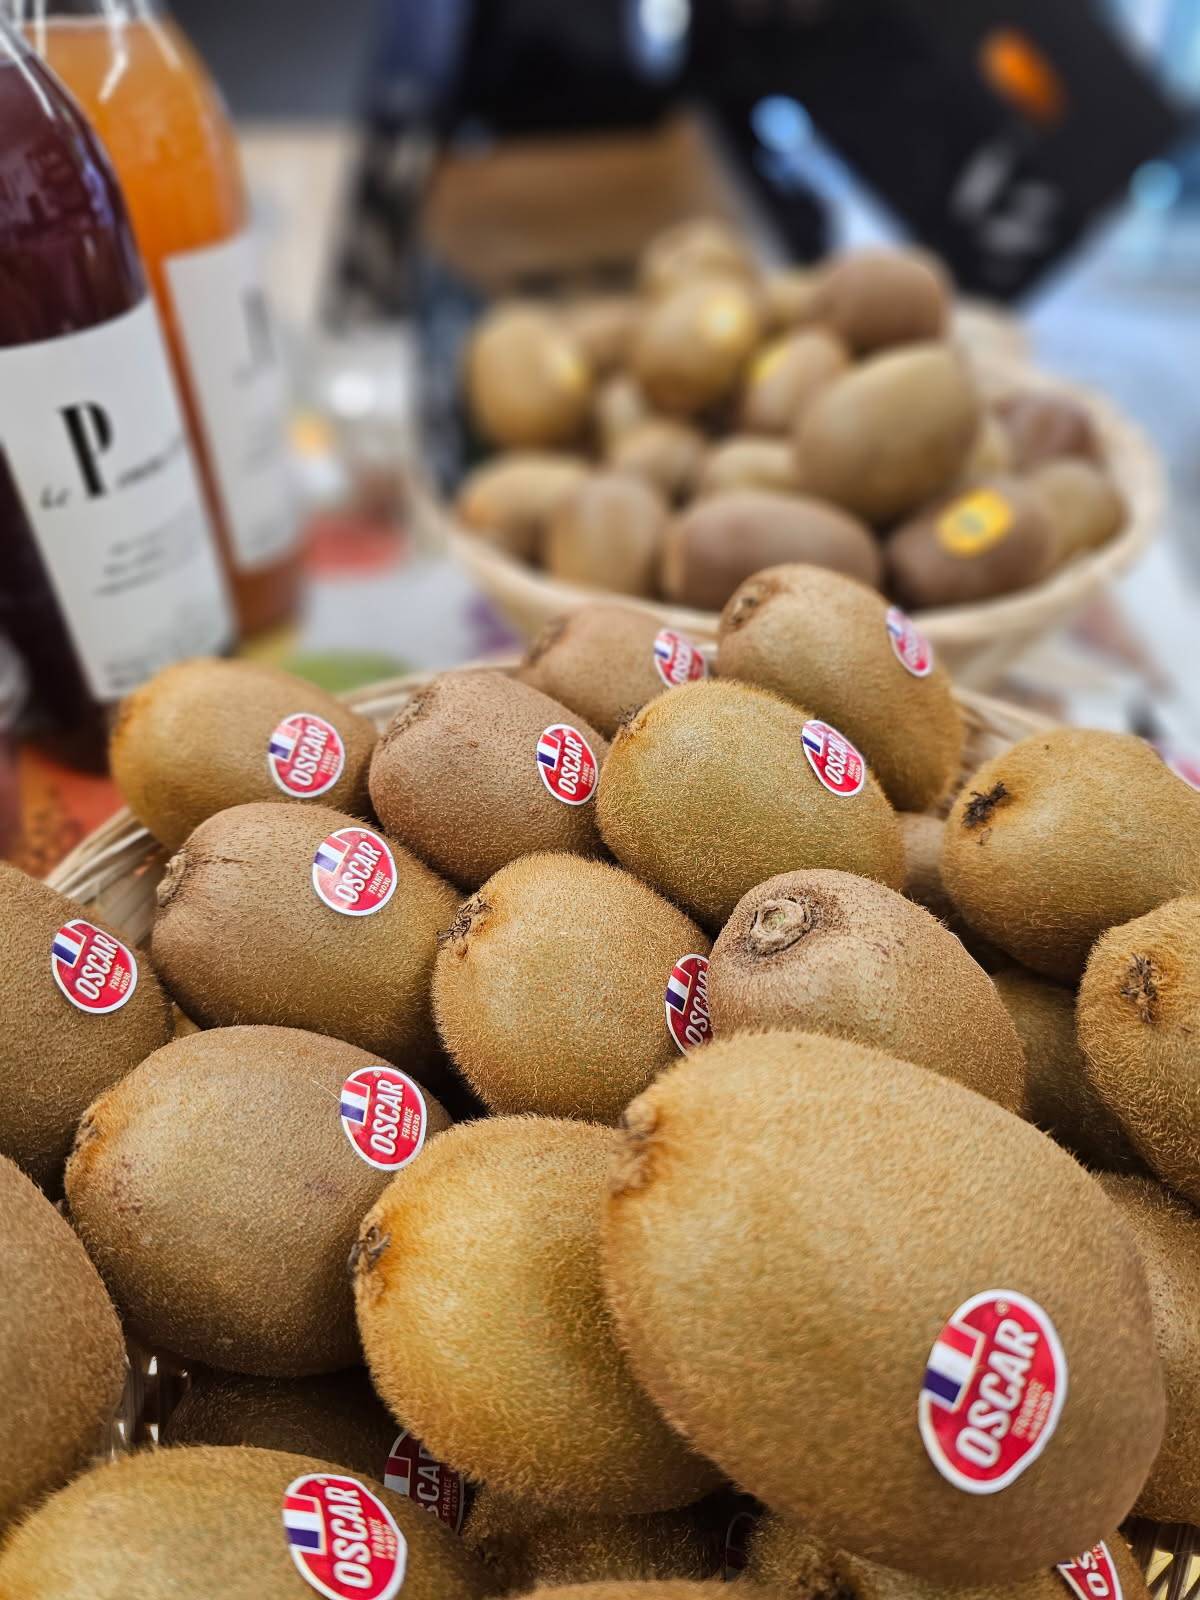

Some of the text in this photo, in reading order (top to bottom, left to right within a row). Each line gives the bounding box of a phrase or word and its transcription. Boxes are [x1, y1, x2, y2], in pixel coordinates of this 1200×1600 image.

[288, 725, 329, 786] OSCAR
[558, 736, 583, 795] OSCAR
[825, 733, 848, 784] OSCAR
[335, 841, 382, 903] OSCAR
[367, 870, 386, 895] FRANCE
[75, 934, 118, 1000] OSCAR
[370, 1079, 403, 1155] OSCAR
[401, 1107, 414, 1139] FRANCE
[955, 1318, 1040, 1469] OSCAR
[324, 1486, 373, 1589] OSCAR
